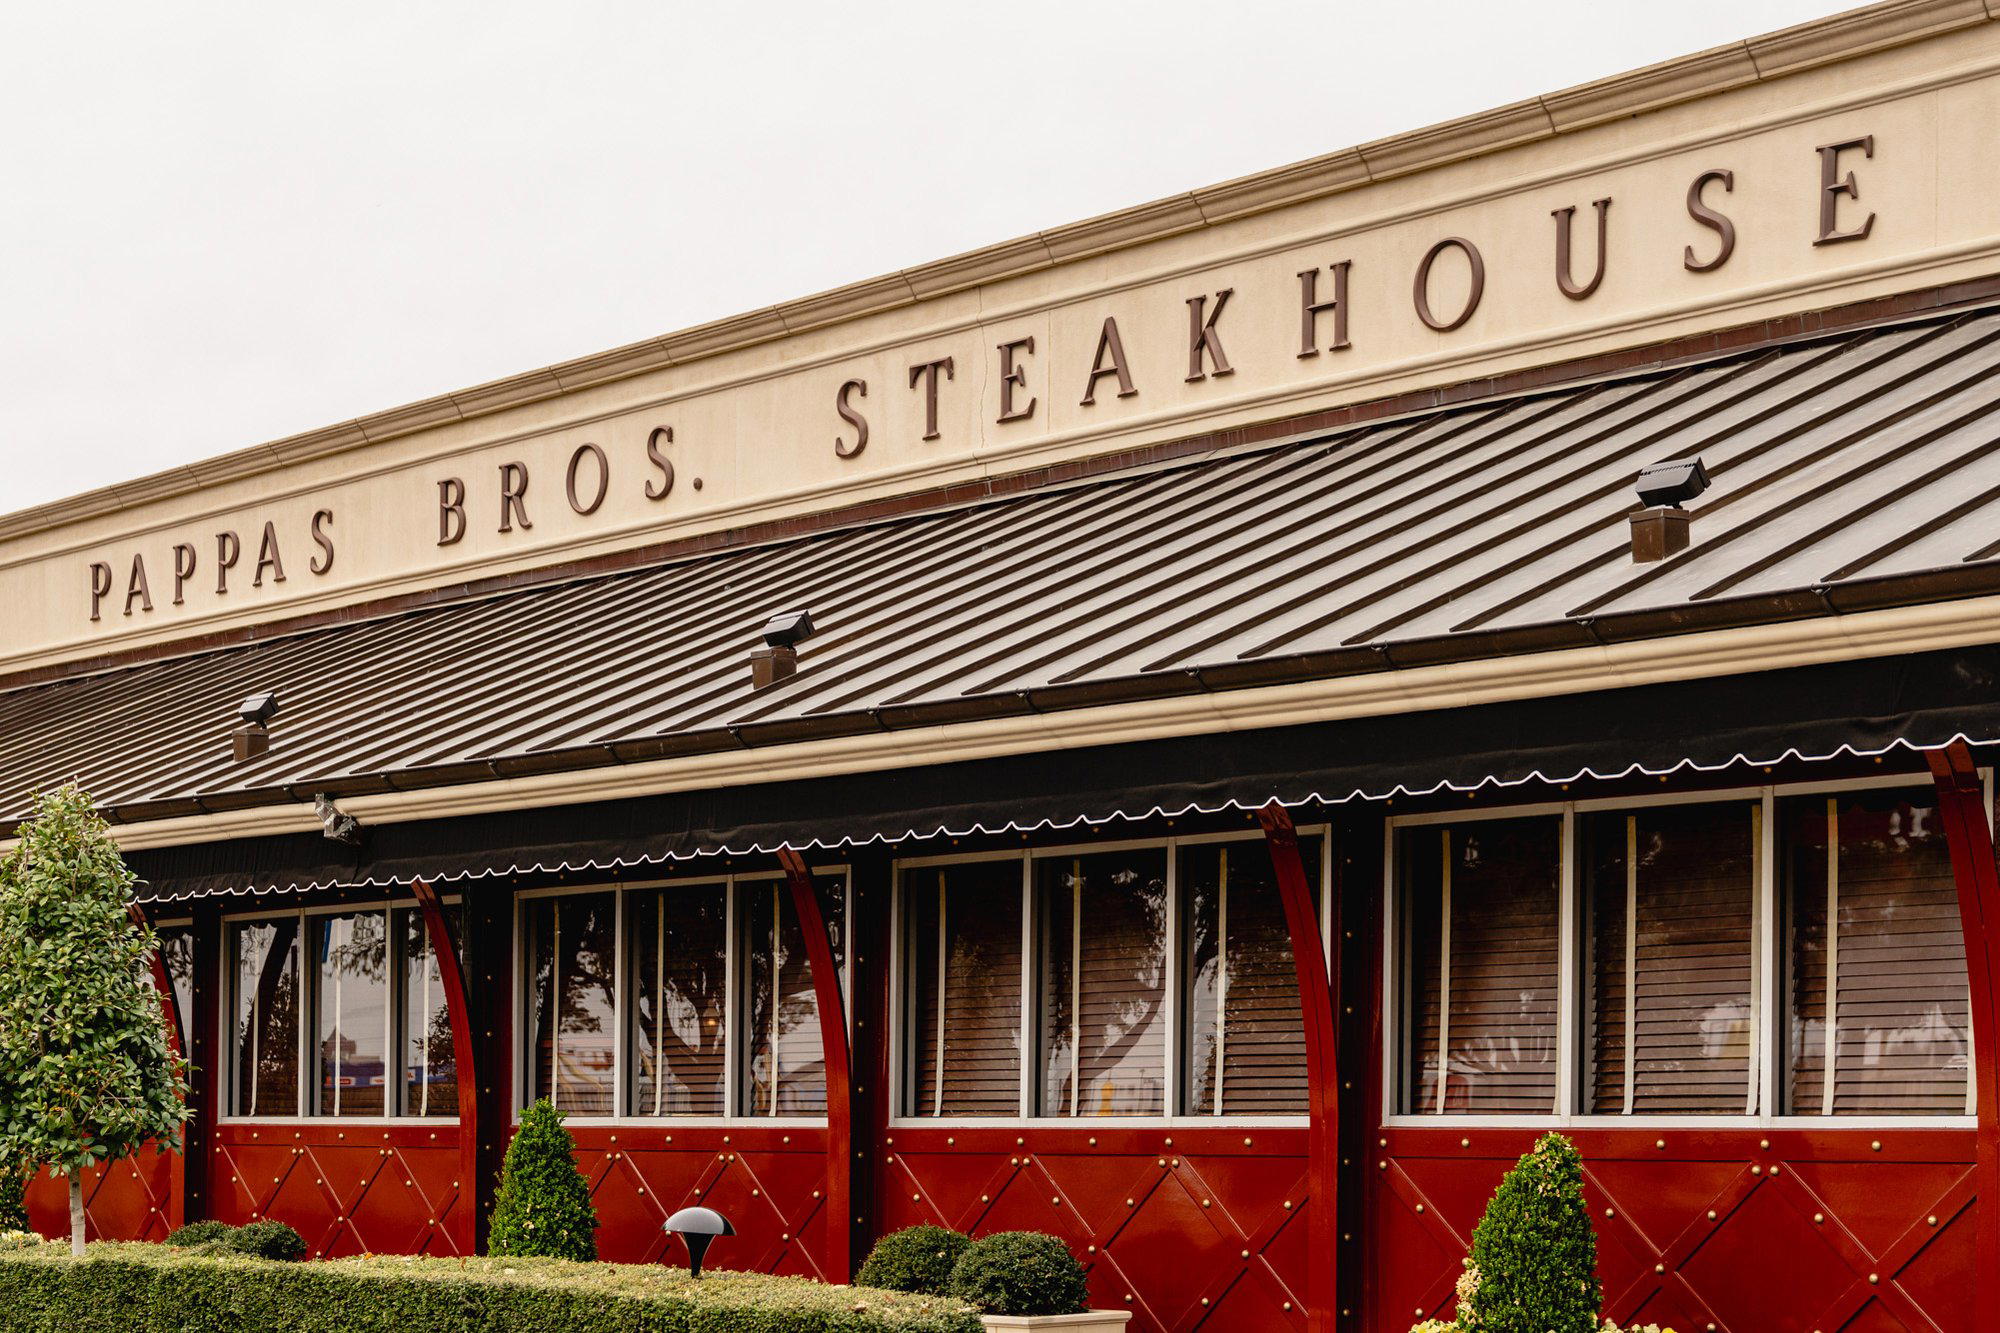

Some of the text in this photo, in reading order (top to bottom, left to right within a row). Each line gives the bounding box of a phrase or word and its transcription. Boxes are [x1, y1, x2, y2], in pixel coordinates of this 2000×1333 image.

[90, 133, 1876, 622] PAPPAS BROS. STEAKHOUSE
